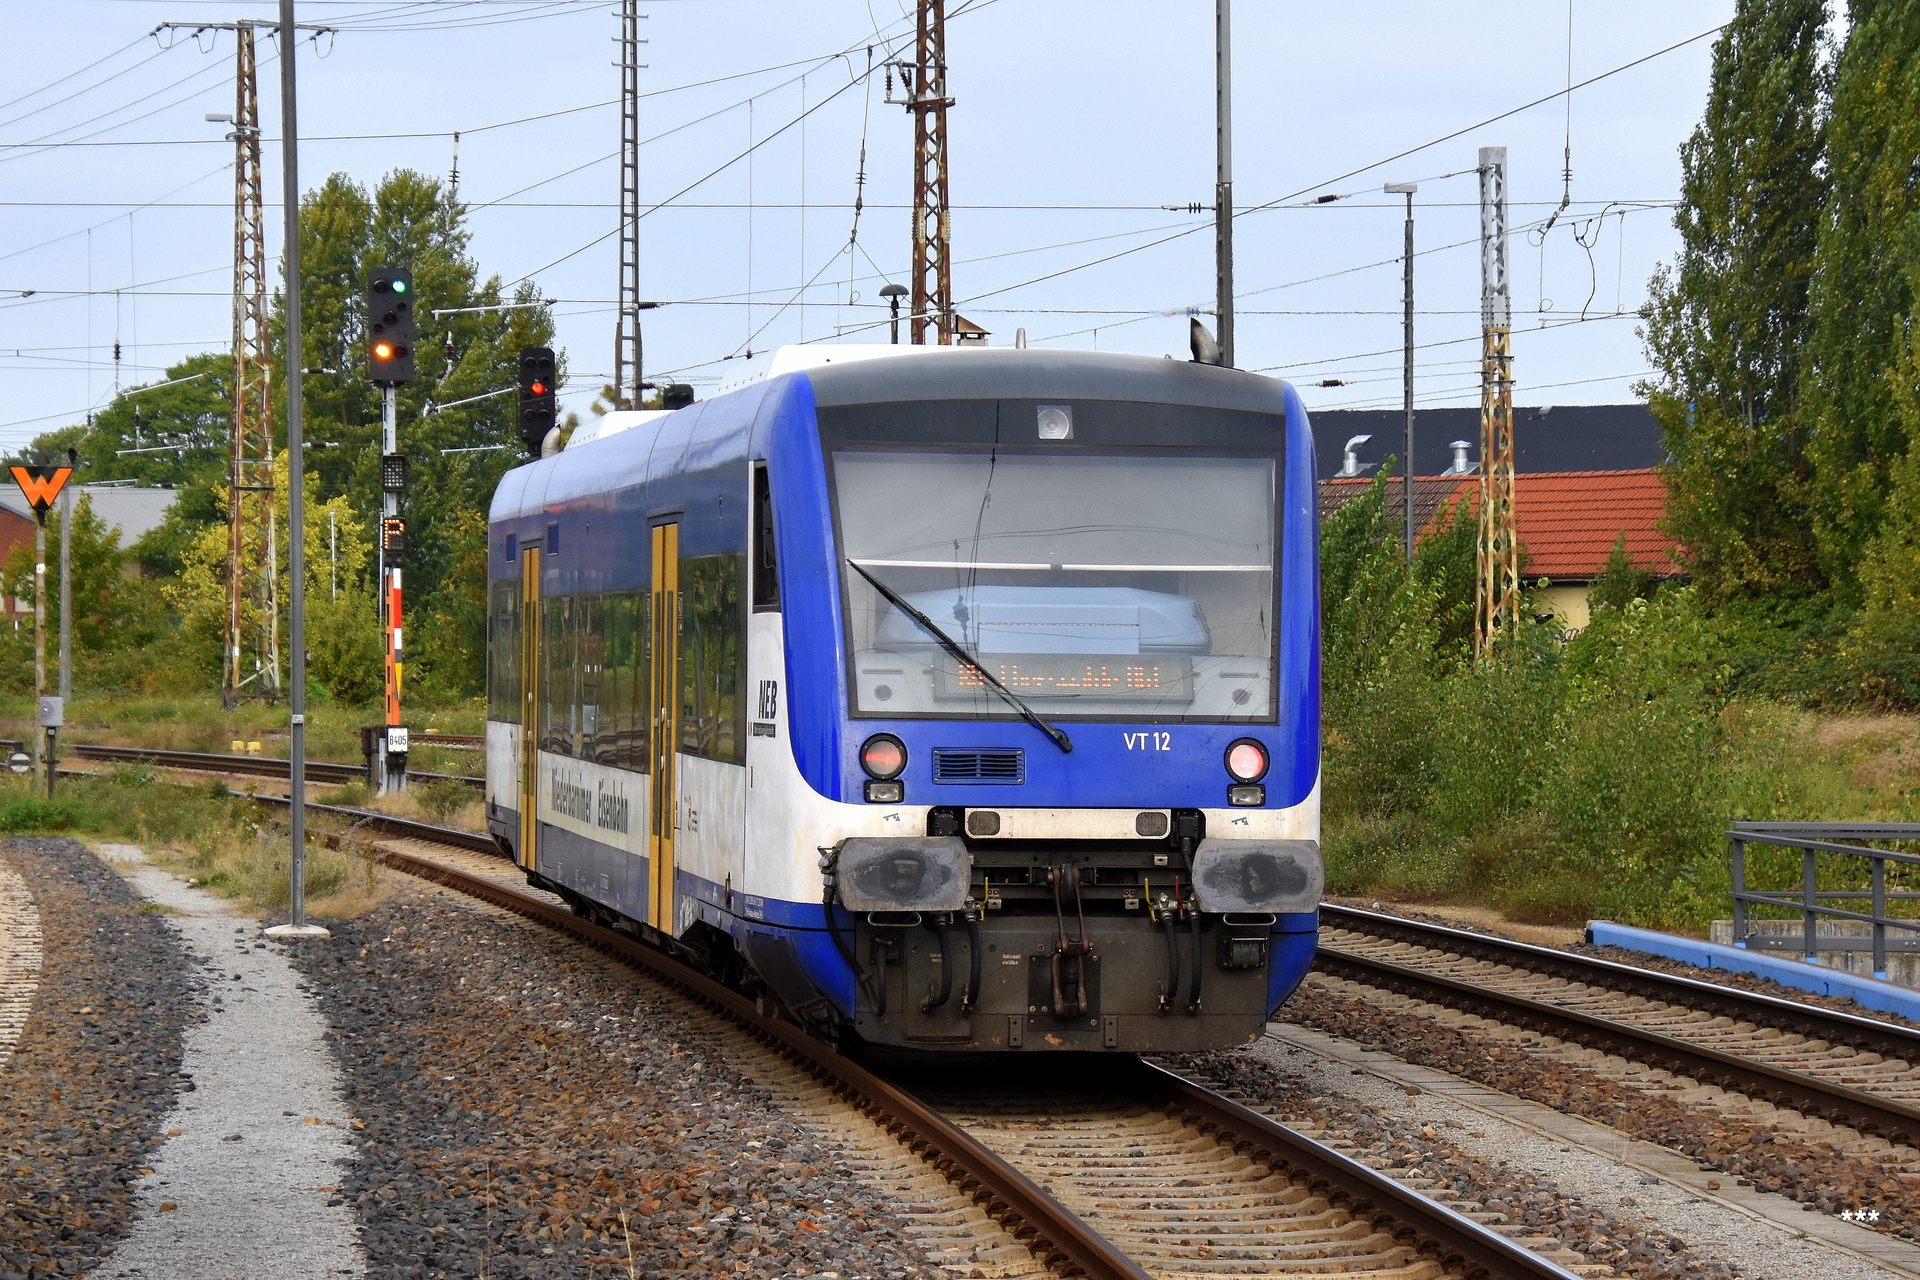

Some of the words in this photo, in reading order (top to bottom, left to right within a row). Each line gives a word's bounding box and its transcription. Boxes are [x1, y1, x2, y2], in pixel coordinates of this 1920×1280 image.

[9, 466, 73, 507] W
[384, 519, 405, 549] P
[758, 680, 777, 719] NEB
[1123, 732, 1149, 750] VT
[1153, 731, 1171, 751] 12
[551, 766, 592, 824] Niederbarnimer
[598, 778, 628, 834] Eisenbahn
